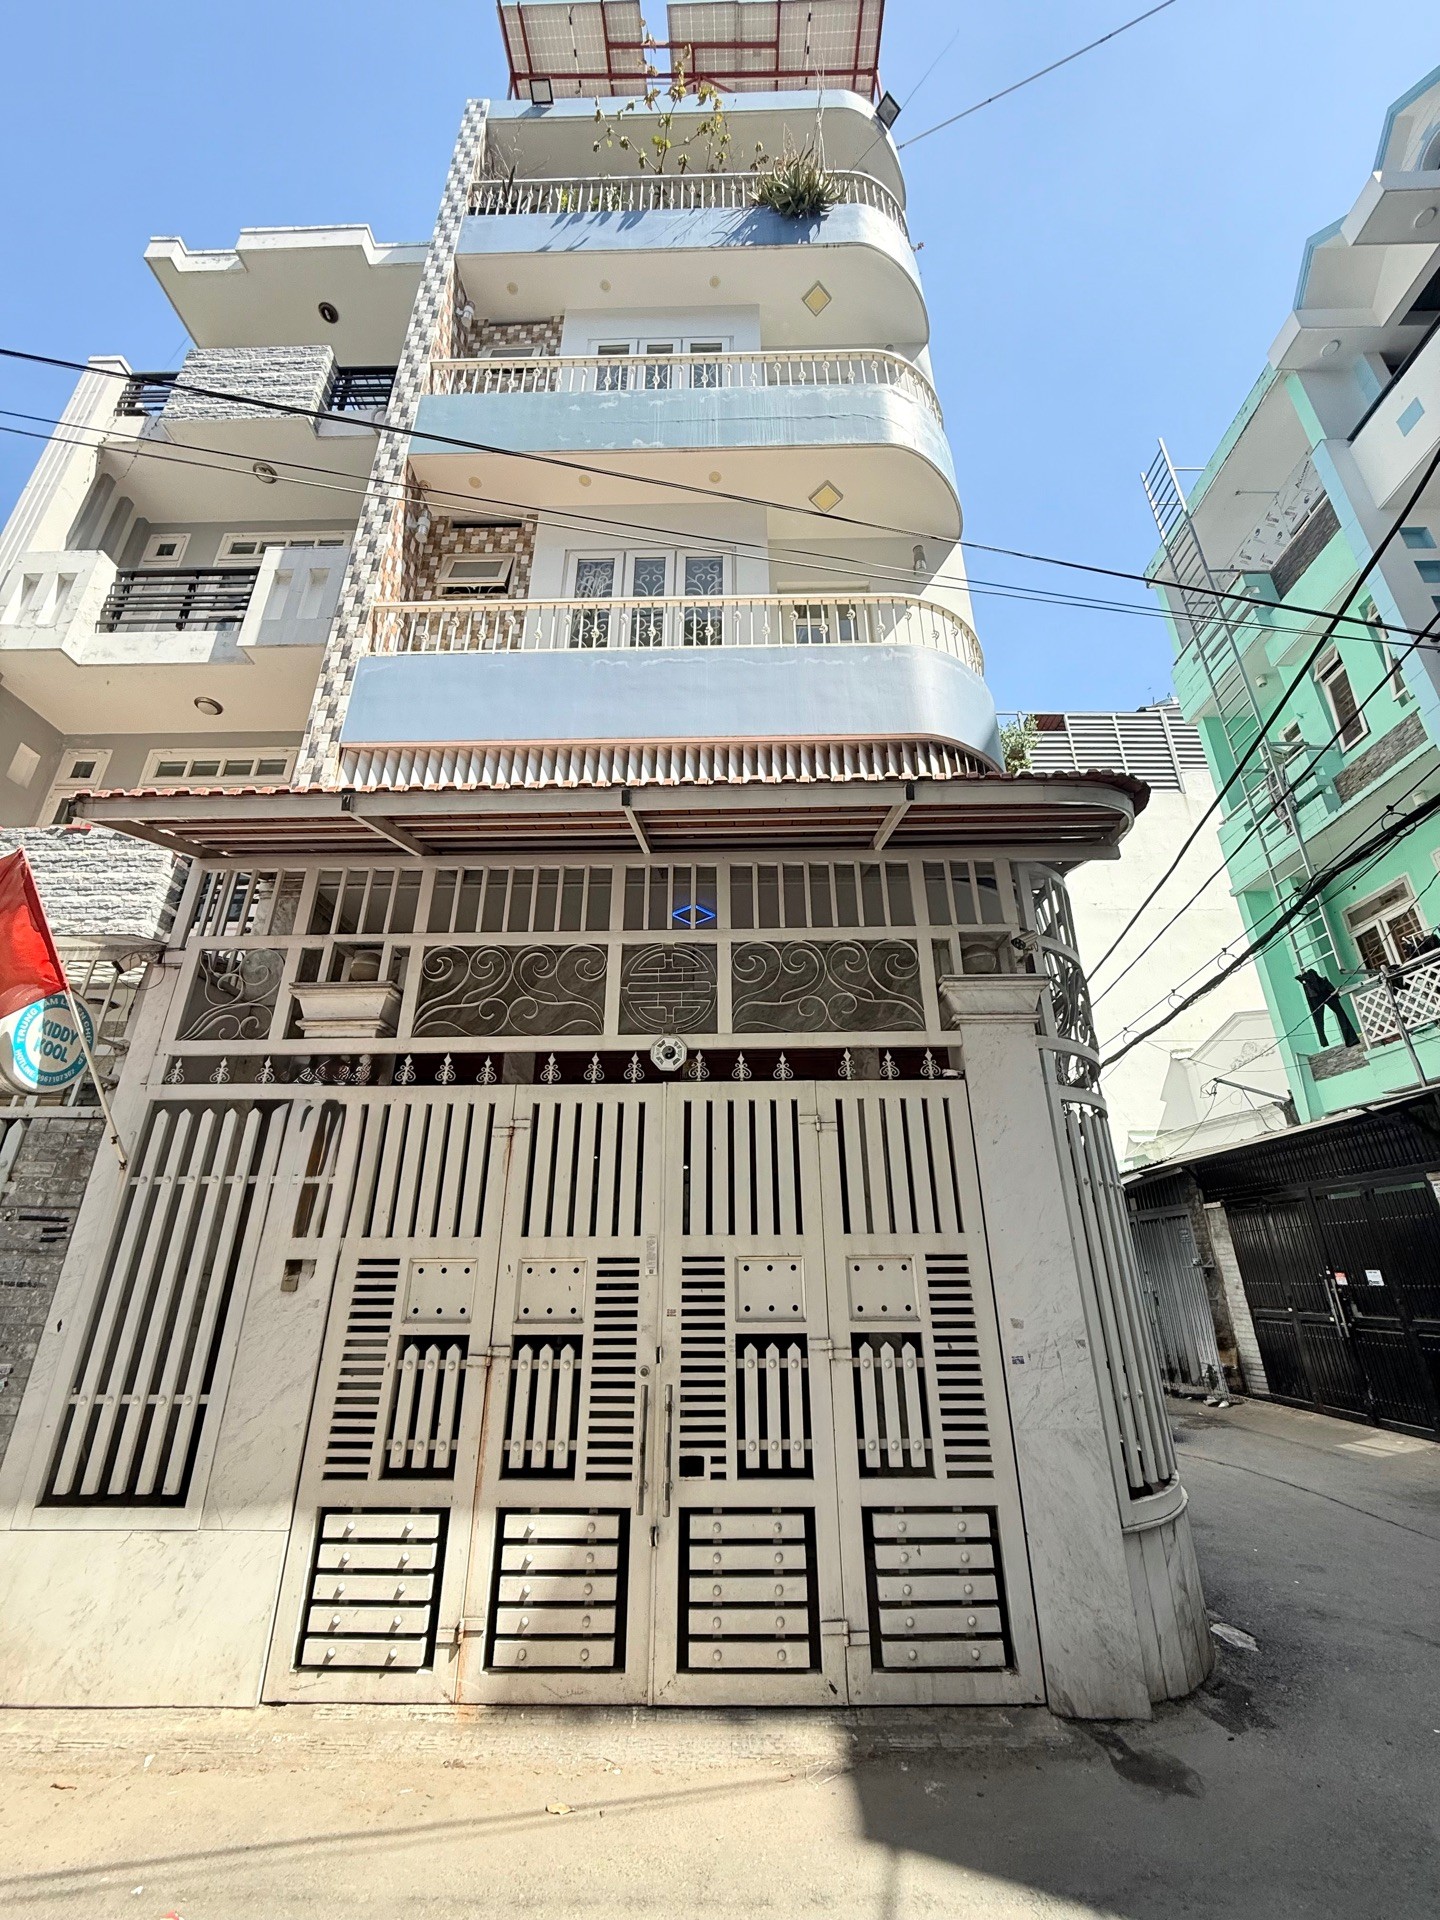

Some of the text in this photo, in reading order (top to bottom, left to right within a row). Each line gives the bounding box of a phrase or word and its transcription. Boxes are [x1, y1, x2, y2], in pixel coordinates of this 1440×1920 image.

[17, 1007, 39, 1043] TRUNG
[39, 1018, 79, 1045] KIDDY
[34, 1036, 67, 1063] KOOL
